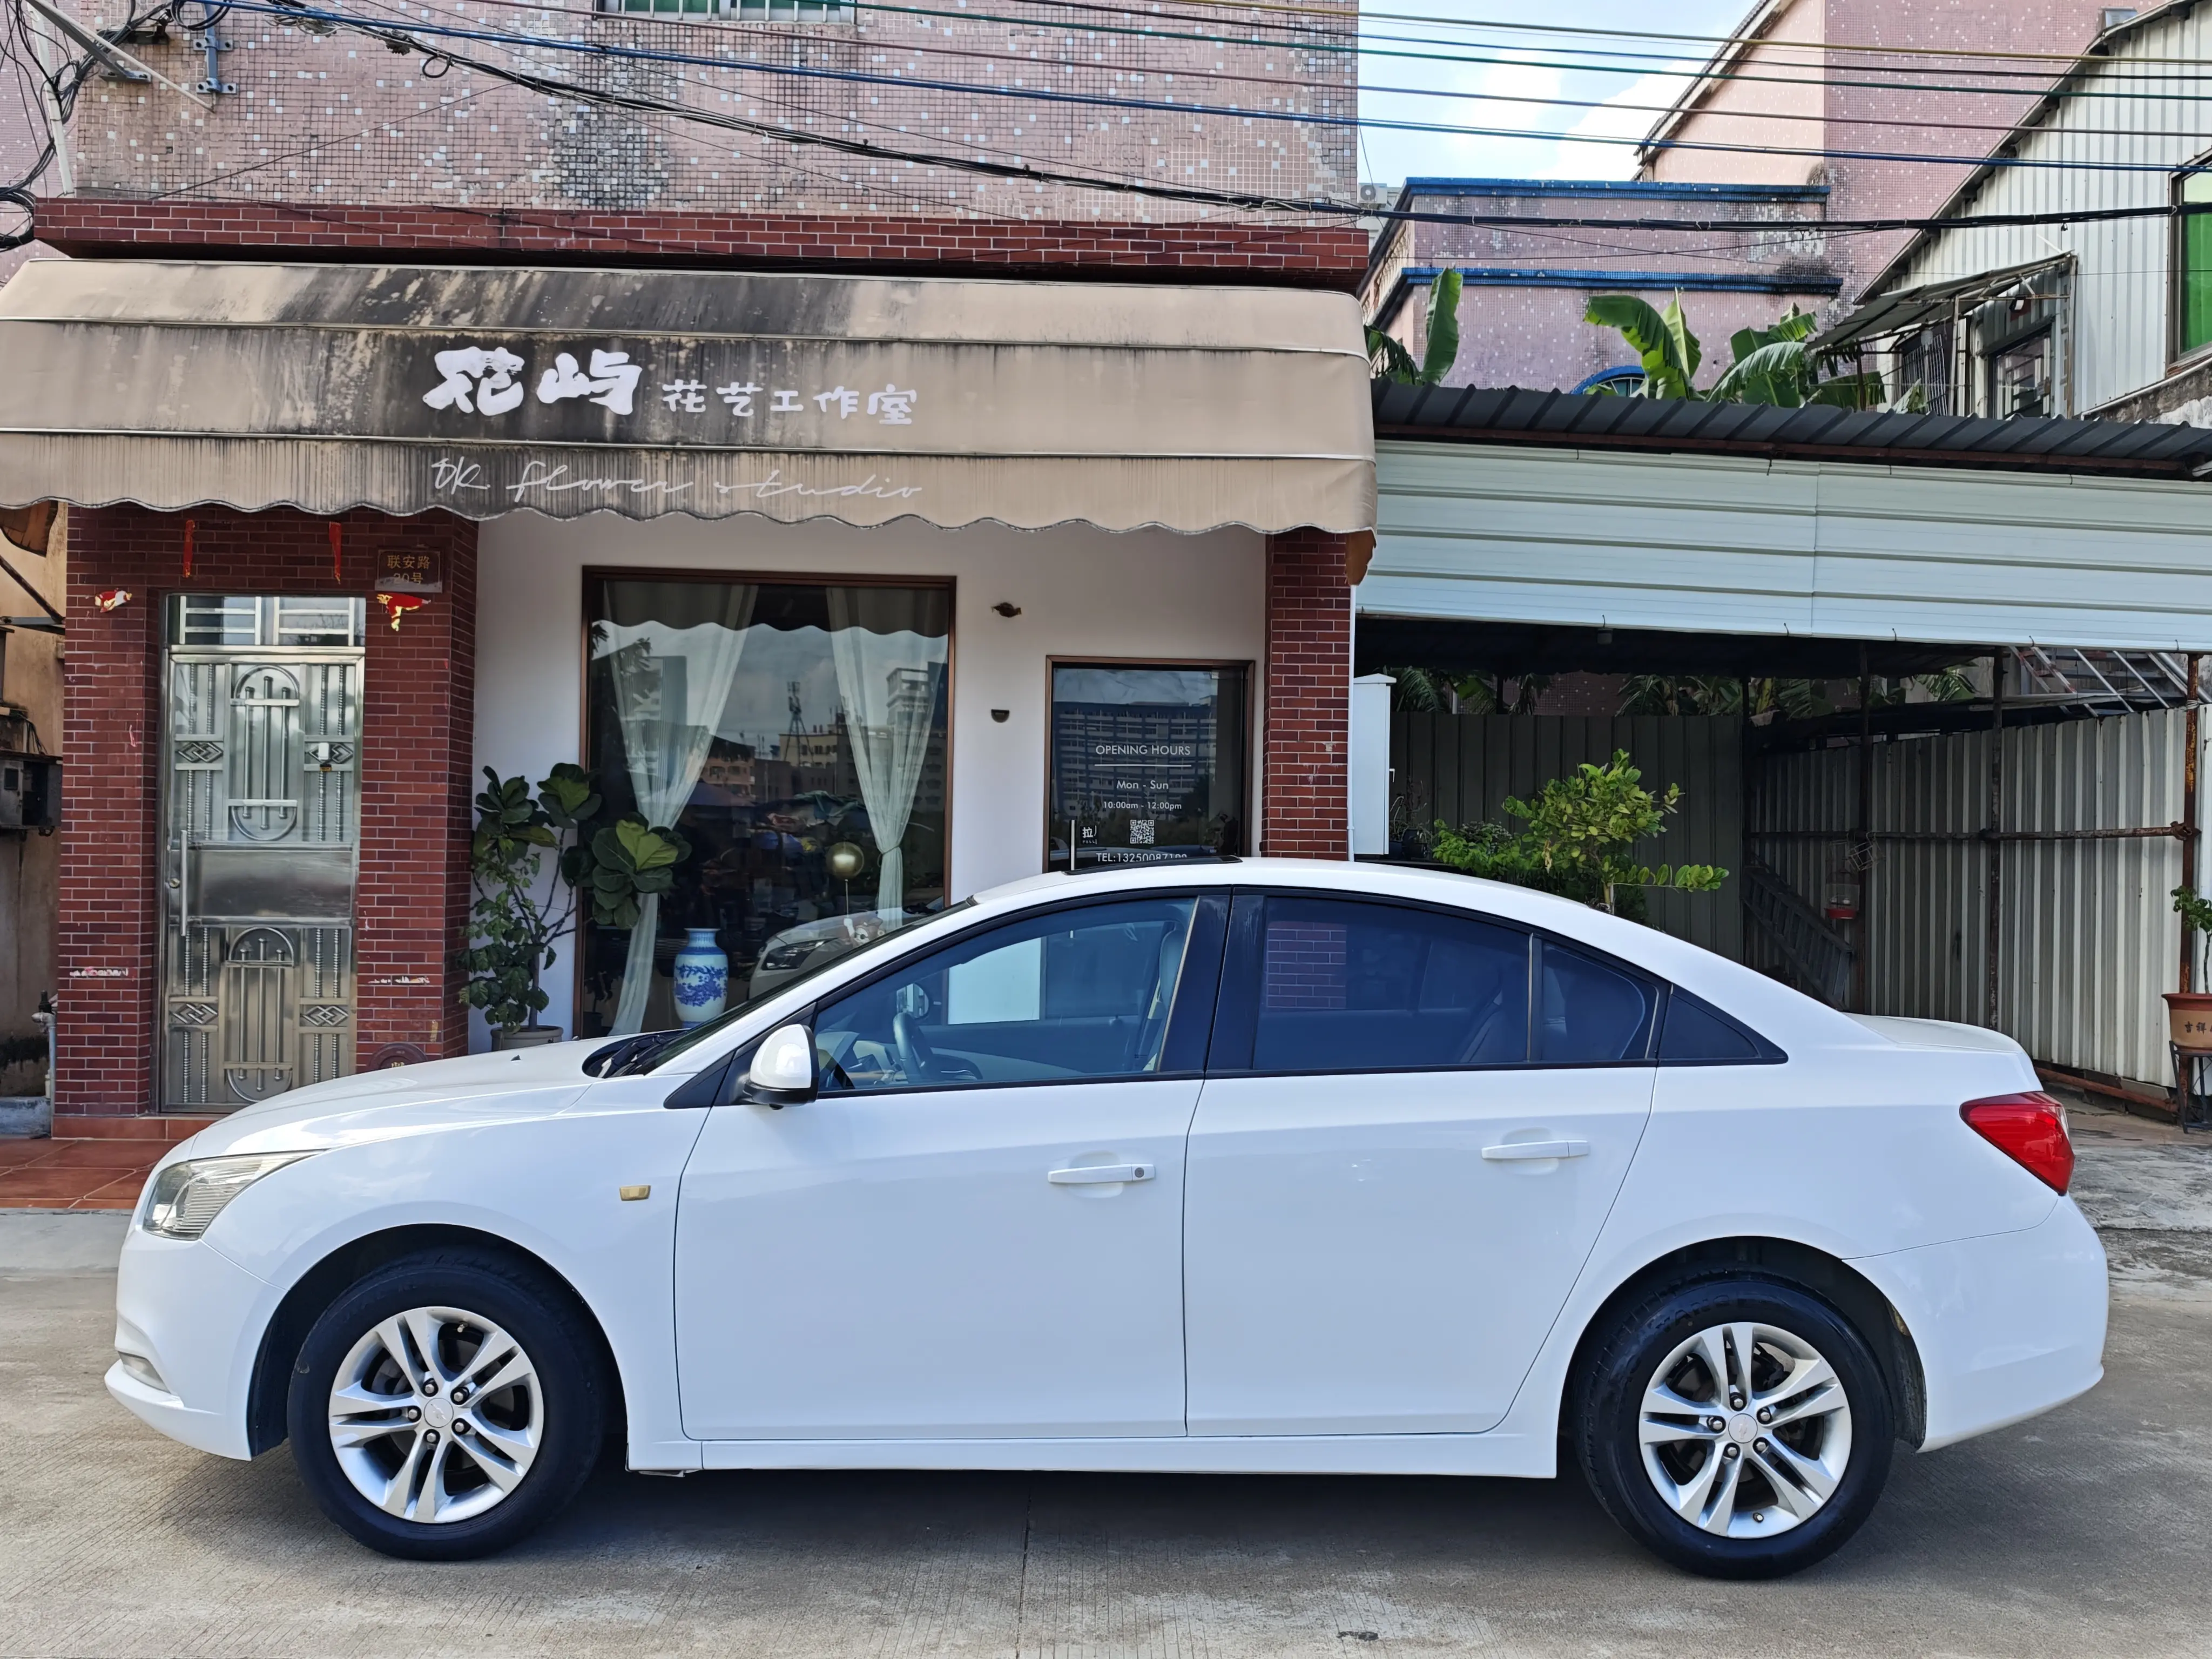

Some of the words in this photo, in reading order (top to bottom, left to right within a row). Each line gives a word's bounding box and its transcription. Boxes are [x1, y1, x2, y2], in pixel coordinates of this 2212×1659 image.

[662, 379, 917, 425] 花艺工作室
[505, 460, 694, 503] flower
[713, 469, 922, 498] studio
[387, 555, 430, 569] 联安路
[1095, 745, 1148, 755] OPENING
[1151, 745, 1191, 756] HOURS
[1116, 780, 1139, 789] Mon
[1150, 780, 1169, 790] Sun
[1103, 801, 1138, 809] 10:00am
[1147, 801, 1182, 811] 12:00pm
[1082, 827, 1094, 838] 拉
[2184, 1021, 2212, 1035] 吉祥
